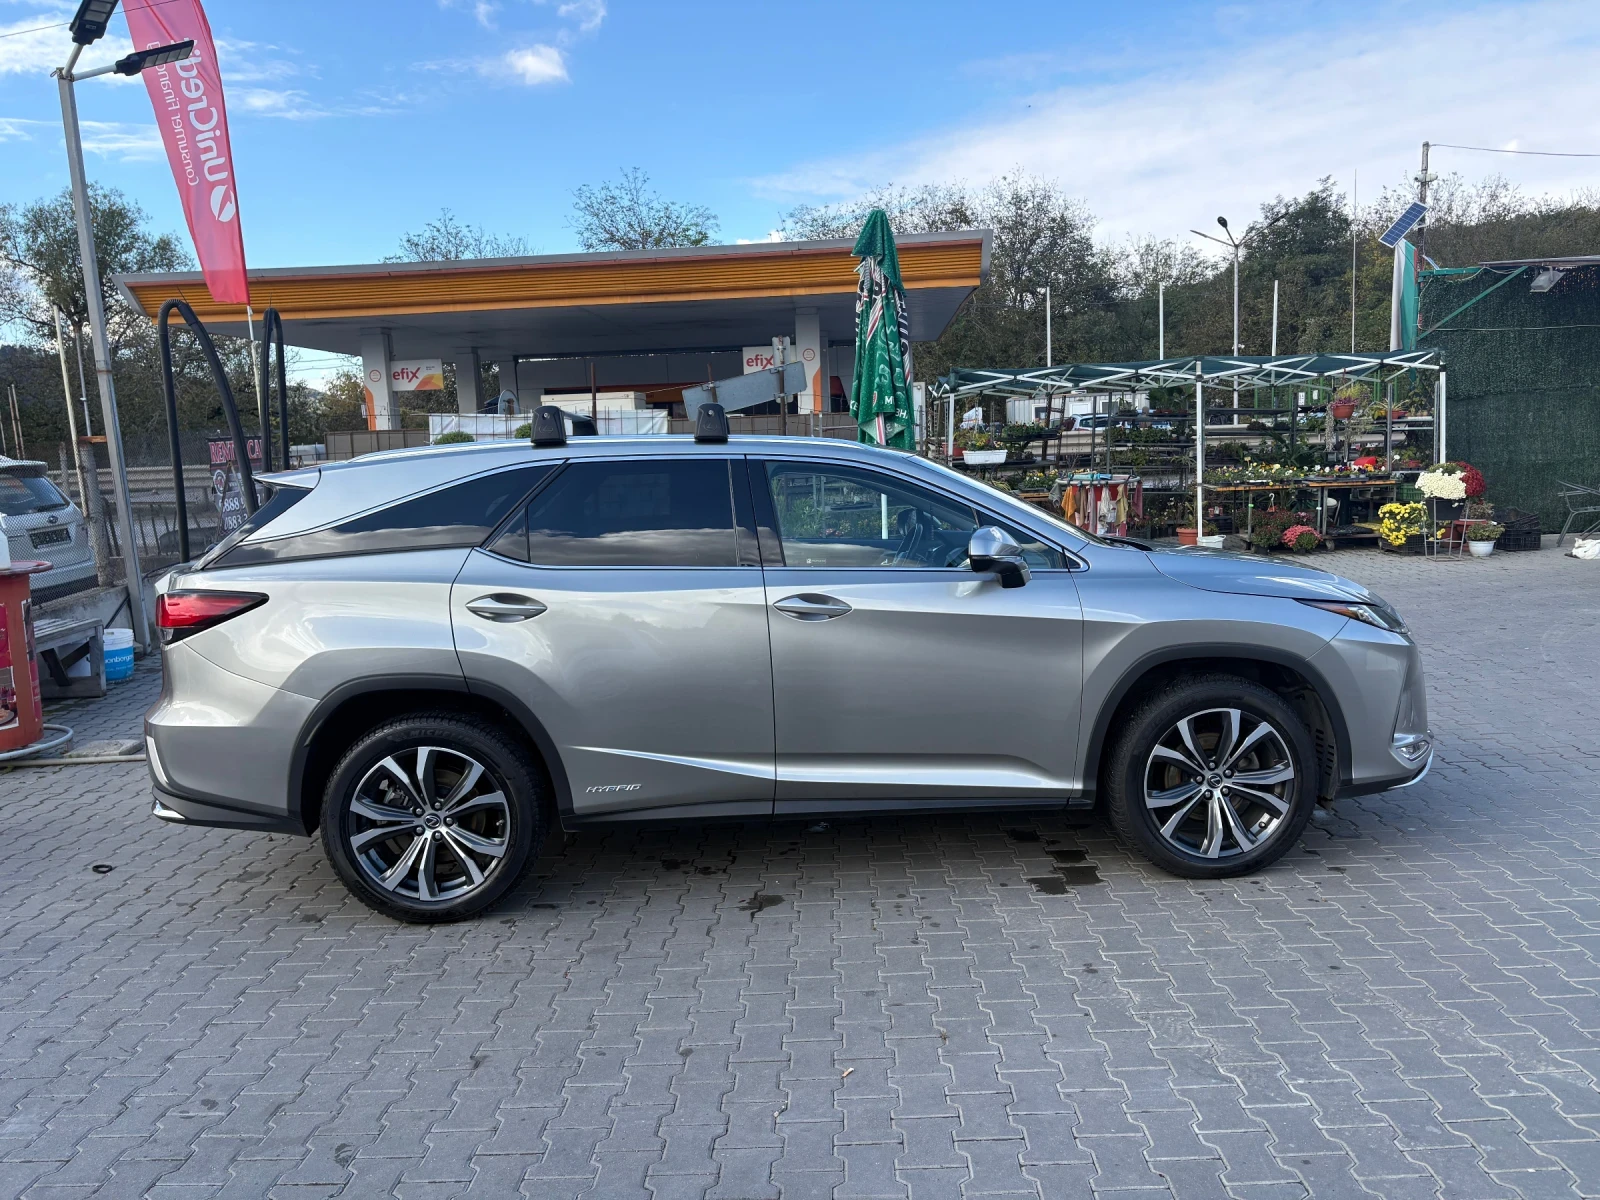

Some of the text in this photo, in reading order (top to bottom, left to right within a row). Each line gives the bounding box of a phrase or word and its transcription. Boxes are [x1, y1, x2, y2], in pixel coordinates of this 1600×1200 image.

[746, 354, 775, 370] efix
[392, 367, 421, 383] efix
[208, 439, 263, 464] RENT CA
[585, 783, 642, 793] HYBRID
